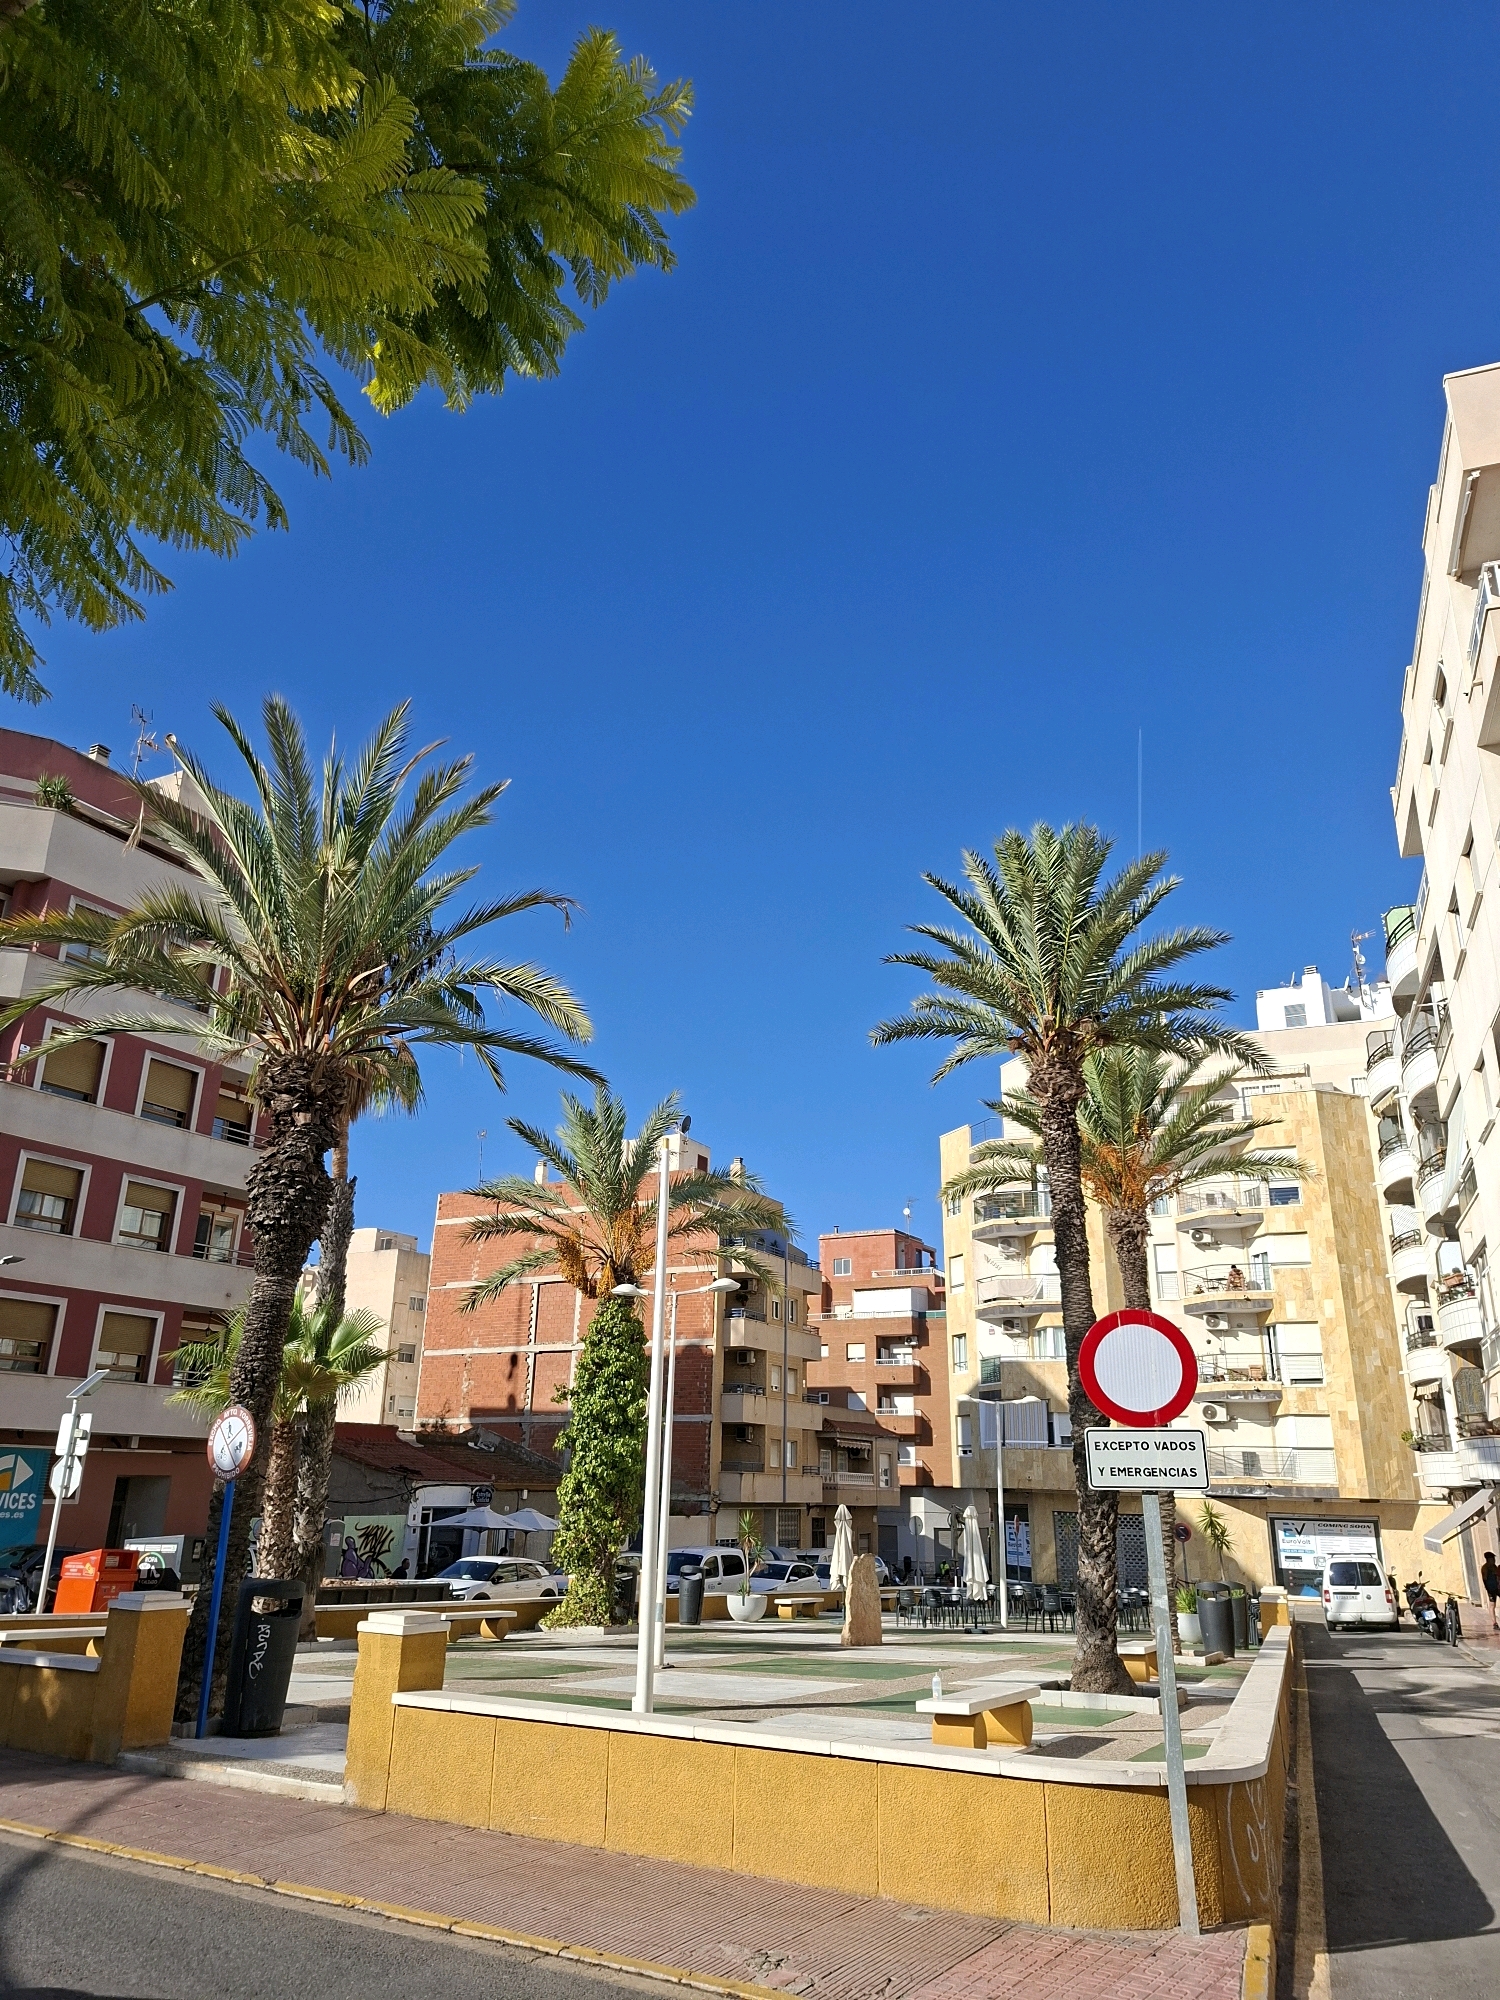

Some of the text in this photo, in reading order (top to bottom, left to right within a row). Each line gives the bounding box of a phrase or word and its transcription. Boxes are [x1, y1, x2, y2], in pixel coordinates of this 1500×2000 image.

[239, 1410, 254, 1451] TORREVIEJA
[1094, 1441, 1197, 1451] EXCEPTO VADOS
[212, 1463, 240, 1479] PROHIBIDO
[1097, 1466, 1198, 1478] Y EMERGENCIAS
